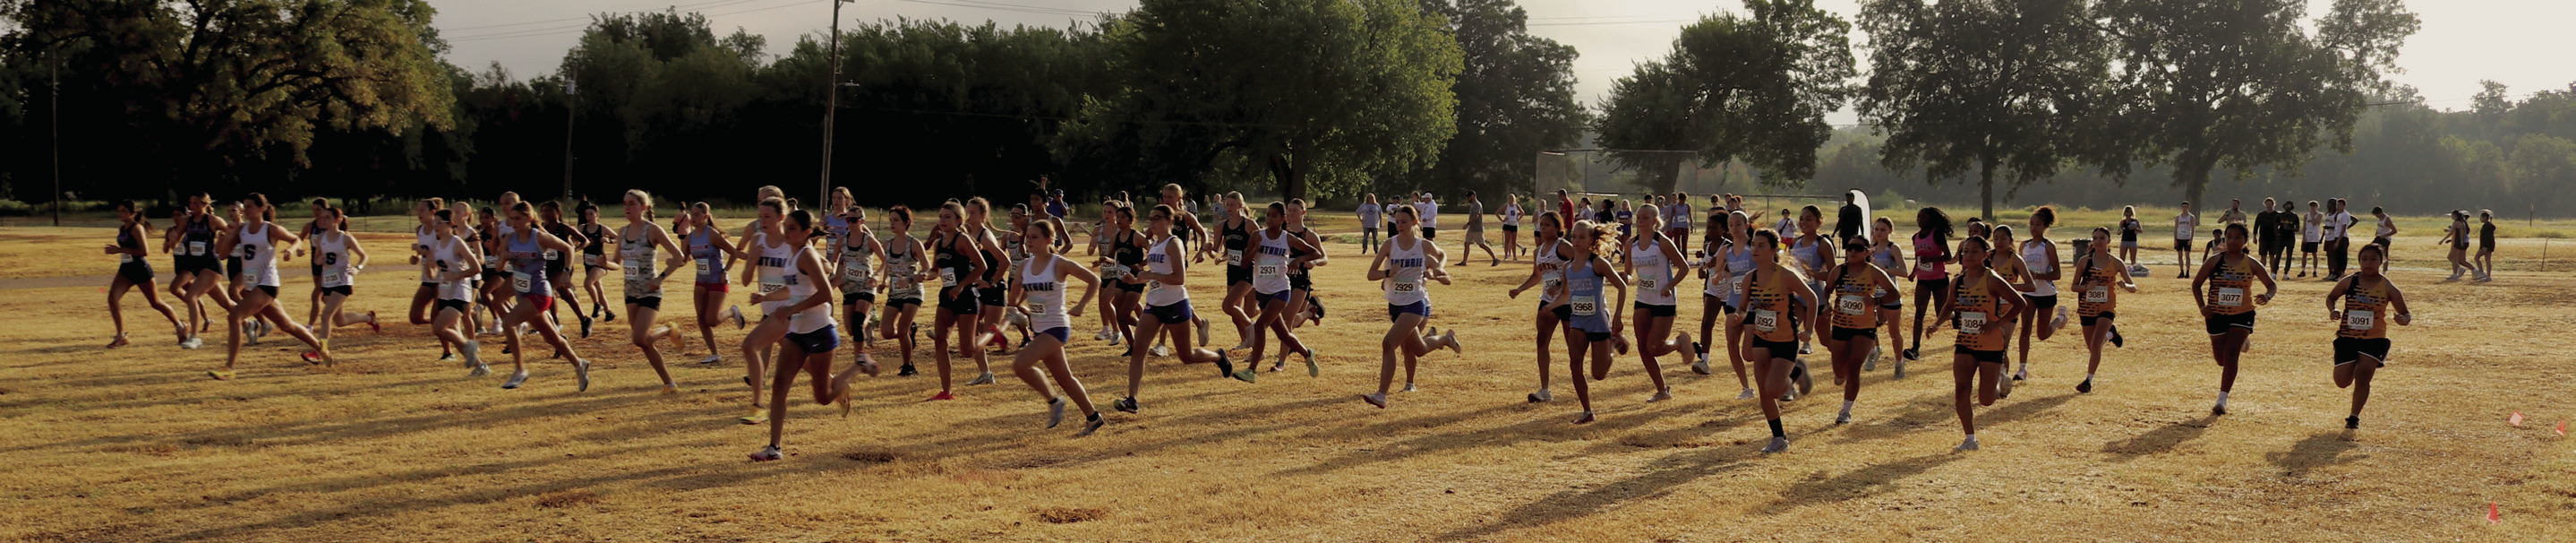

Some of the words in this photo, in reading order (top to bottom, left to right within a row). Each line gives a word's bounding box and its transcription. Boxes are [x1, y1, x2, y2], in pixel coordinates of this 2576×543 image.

[244, 244, 256, 261] S
[325, 252, 337, 265] S
[848, 268, 862, 277] 3201
[1260, 266, 1276, 274] 2931
[1395, 283, 1414, 291] 2929
[2221, 294, 2241, 302] 3077
[1573, 302, 1594, 312] 2968
[1843, 300, 1863, 311] 3090
[1757, 315, 1774, 327] 3092
[1964, 319, 1984, 329] 3084
[2349, 316, 2370, 325] 3091
